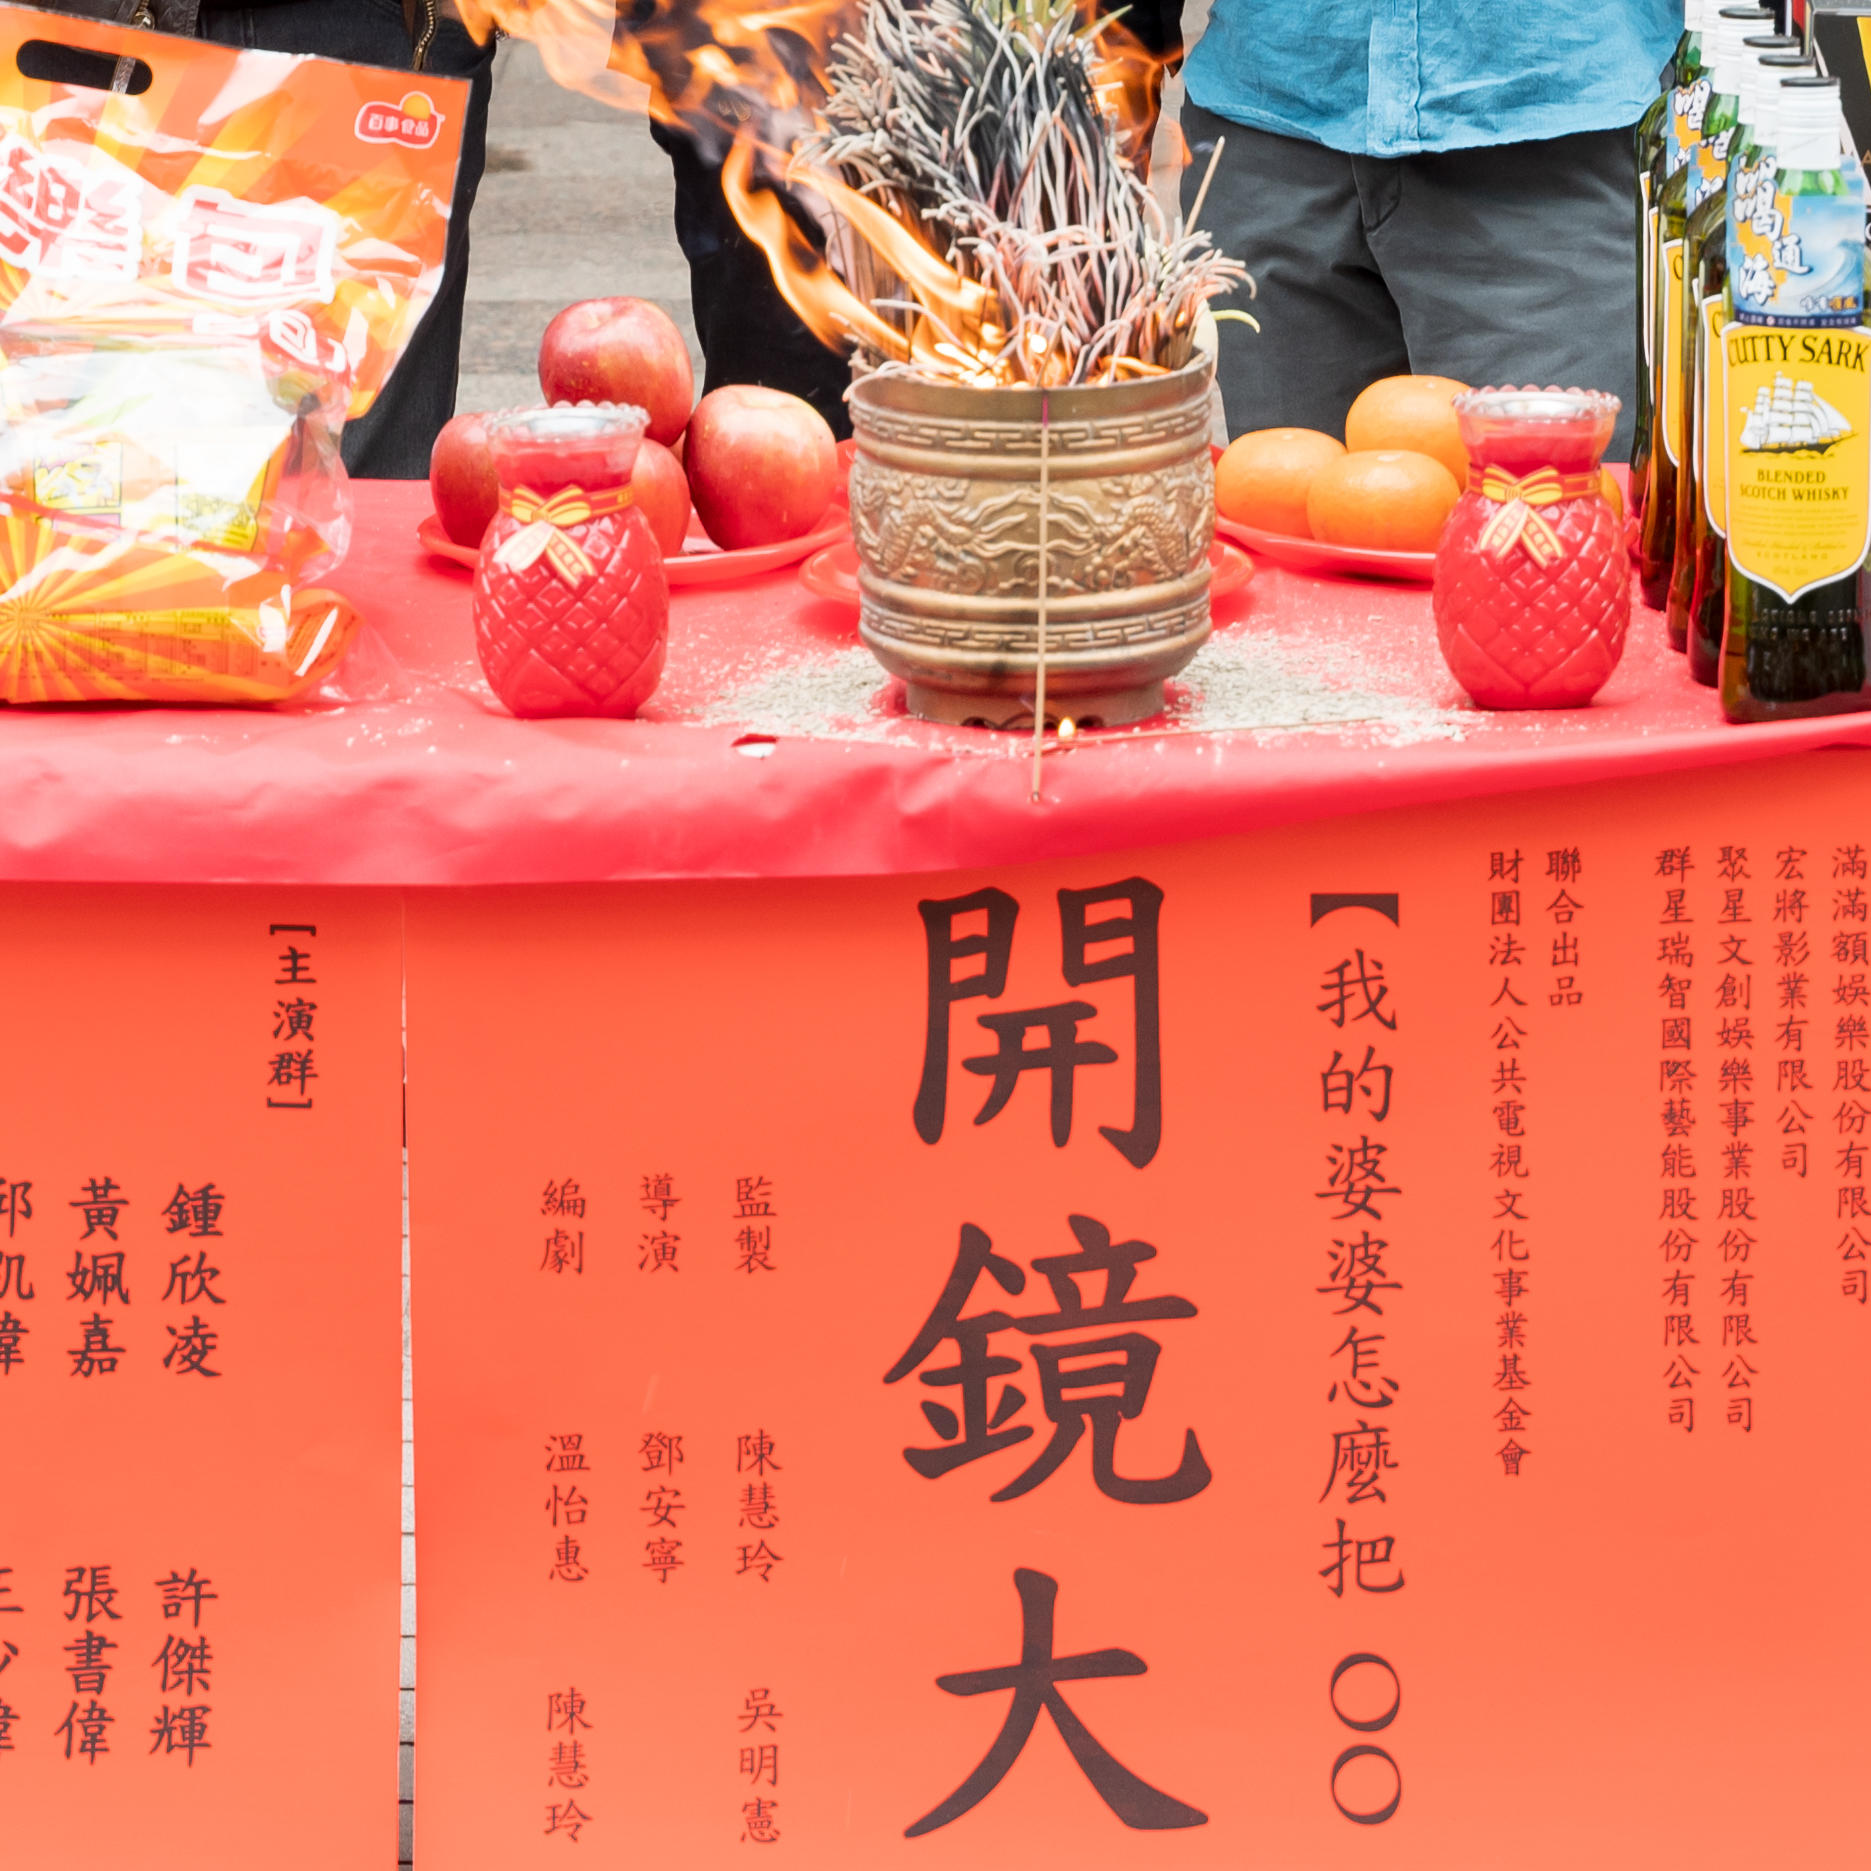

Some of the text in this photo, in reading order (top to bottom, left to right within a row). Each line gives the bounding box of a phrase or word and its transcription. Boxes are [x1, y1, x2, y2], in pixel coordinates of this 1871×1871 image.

[1728, 335, 1870, 373] CUTTY SARK
[1740, 484, 1849, 501] SCOTCH WHISKY
[1757, 469, 1826, 484] BLENDED
[1545, 846, 1584, 1006] 聯合出品
[1774, 846, 1813, 1178] 宏將影業有限公司
[1489, 848, 1531, 1476] 財團法人公共電視文化事業基金會
[1655, 846, 1700, 1433] 群星瑞智國際藝能股份有限公司
[1717, 845, 1758, 1433] 聚星文創娛樂事業股份有限公司
[66, 1176, 131, 1378] 黃姵嘉
[161, 1182, 227, 1378] 鍾欣凌
[541, 1178, 586, 1275] 編劇
[638, 1173, 681, 1272] 導演
[734, 1176, 777, 1274] 監製
[882, 875, 1213, 1839] 開鏡大
[545, 1434, 590, 1582] 溫怡惠
[642, 1432, 685, 1584] 鄧安寧
[736, 1429, 782, 1582] 陳慧玲
[54, 1565, 123, 1765] 張書偉
[149, 1567, 218, 1767] 許傑輝
[545, 1687, 592, 1842] 陳慧玲
[740, 1689, 782, 1843] 吳明憲
